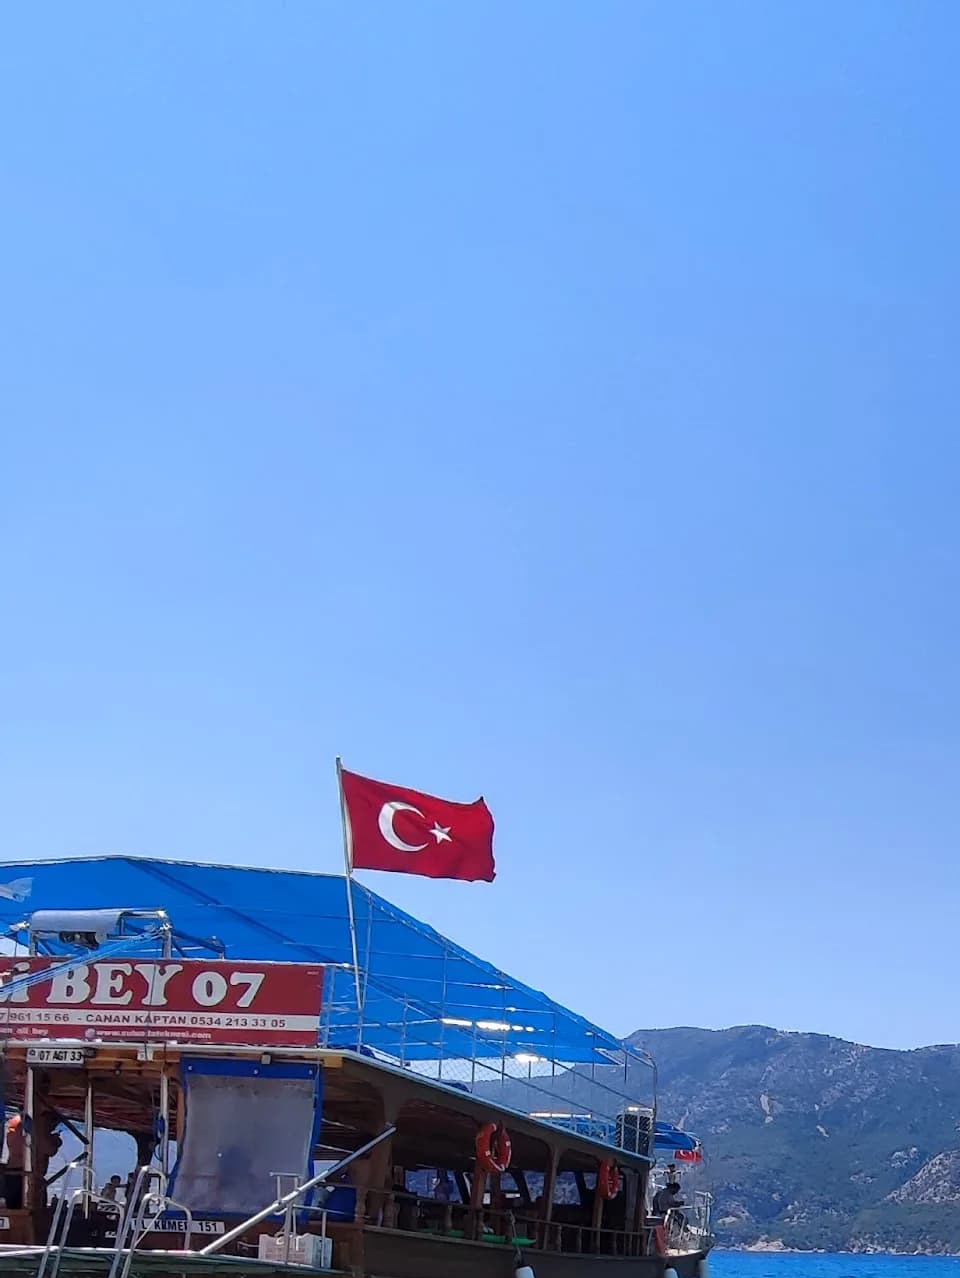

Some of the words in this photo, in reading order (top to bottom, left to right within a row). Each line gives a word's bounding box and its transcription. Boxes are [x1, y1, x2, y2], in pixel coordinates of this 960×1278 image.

[46, 962, 184, 1006] BEY
[192, 971, 265, 1008] 07
[10, 1012, 31, 1021] 961
[36, 1013, 50, 1021] 15
[54, 1013, 70, 1022] 66
[86, 1014, 131, 1024] CANAN
[134, 1015, 187, 1026] KAPTAN
[190, 1016, 221, 1026] 0534
[225, 1017, 248, 1027] 213
[252, 1018, 266, 1028] 33
[271, 1019, 286, 1028] 05
[40, 1050, 50, 1061] 07
[70, 1051, 82, 1062] 33
[198, 1222, 217, 1232] 151
